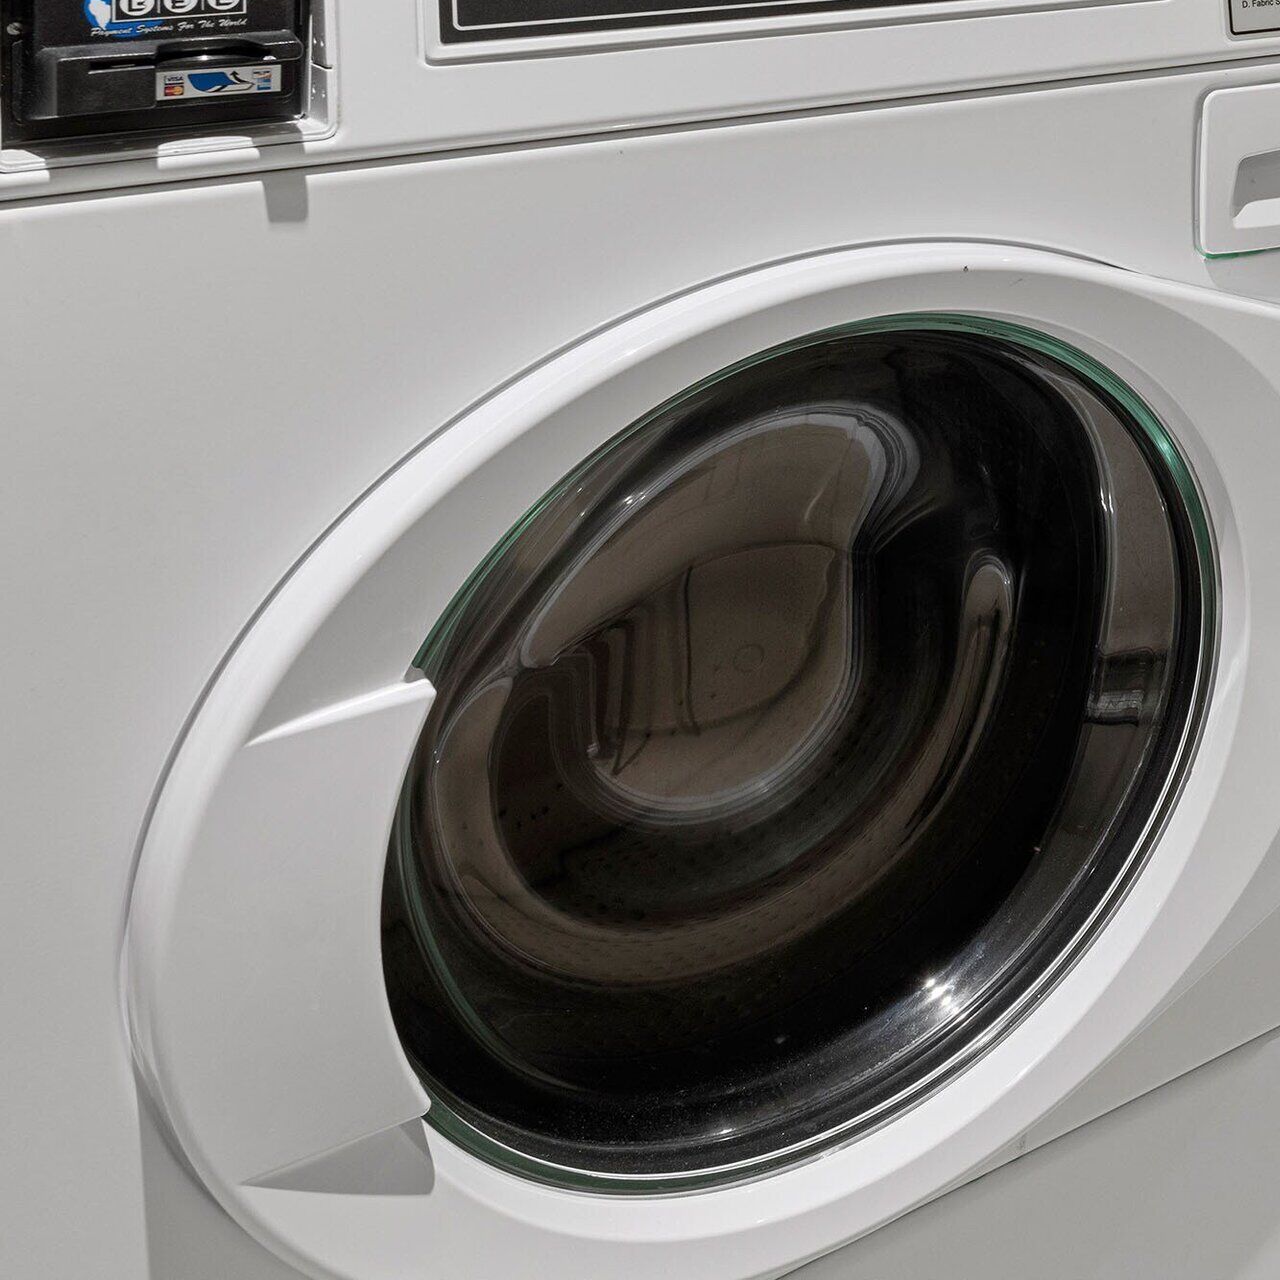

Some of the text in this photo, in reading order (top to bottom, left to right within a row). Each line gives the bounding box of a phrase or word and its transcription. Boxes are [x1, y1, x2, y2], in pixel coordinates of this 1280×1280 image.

[90, 18, 247, 36] Payment Systems For The World
